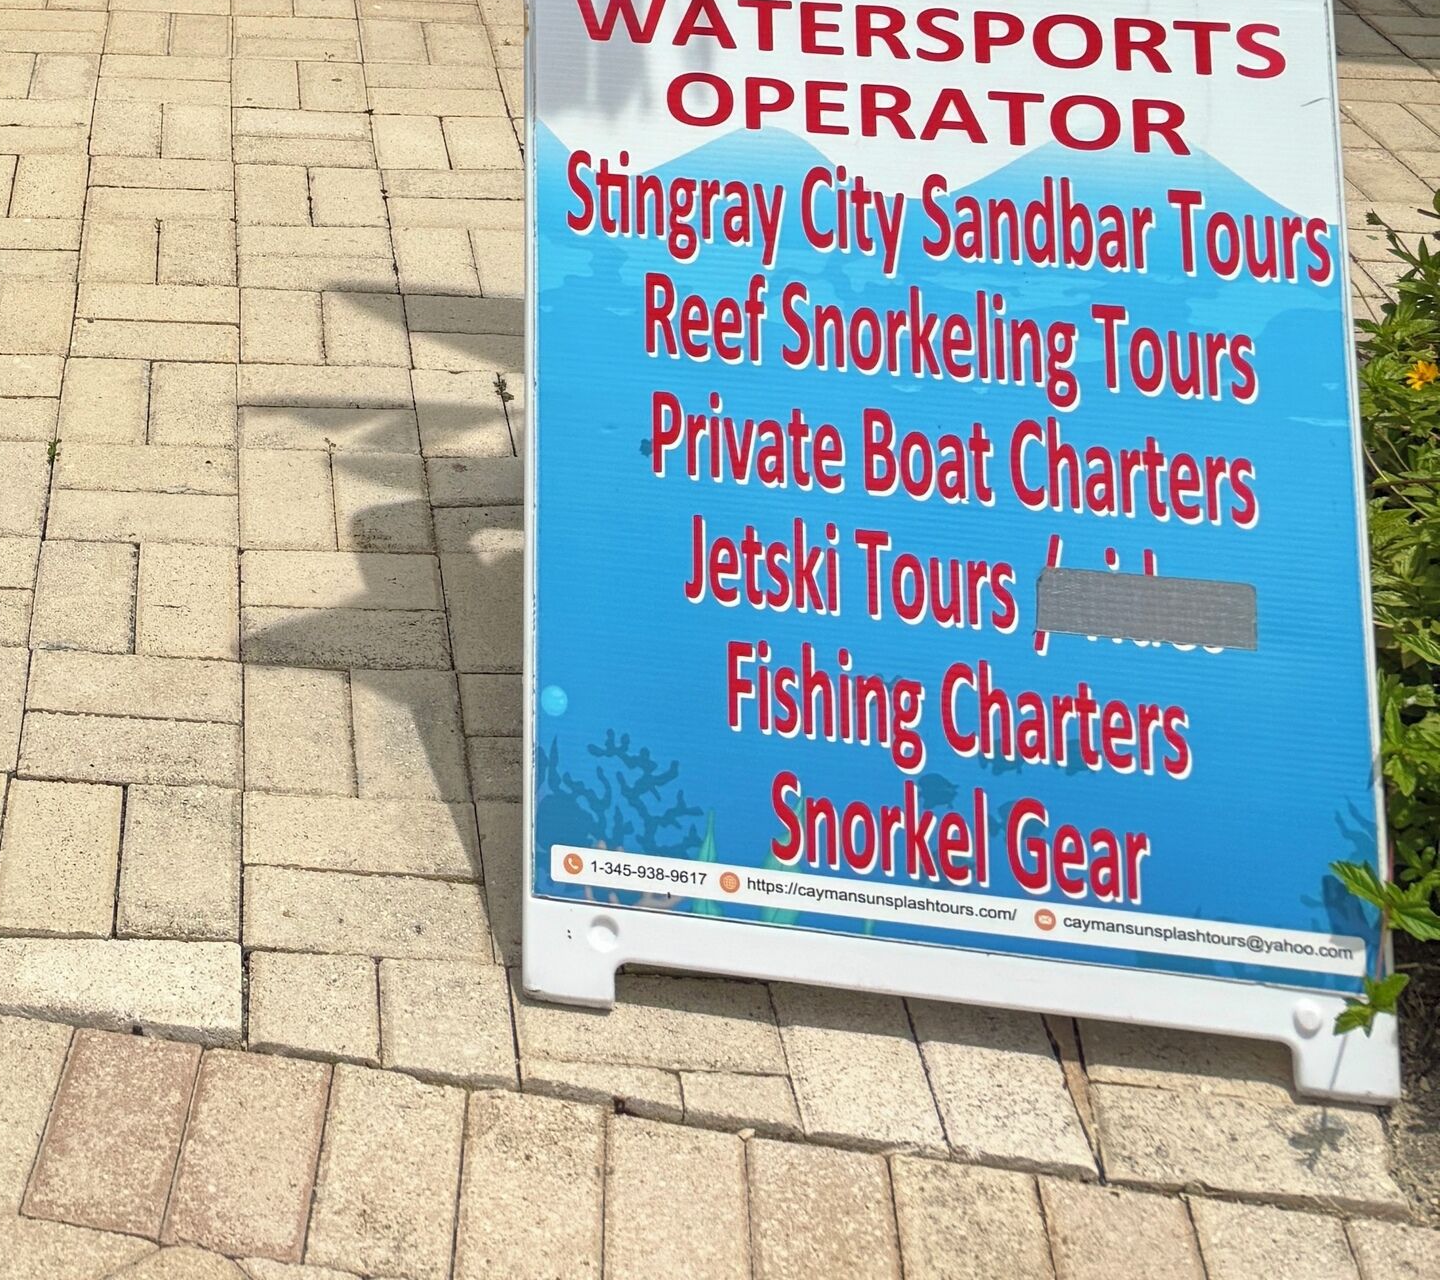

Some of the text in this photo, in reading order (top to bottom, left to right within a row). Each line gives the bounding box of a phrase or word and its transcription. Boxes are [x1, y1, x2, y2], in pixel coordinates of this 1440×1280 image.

[665, 71, 1194, 157] OPERATOR
[565, 149, 1337, 288] Stingray City Sandbar Tours
[643, 271, 1261, 413] Reef Snorkeling Tours
[650, 389, 1261, 530] Private Boat Charters
[683, 513, 842, 618] Jetski
[854, 528, 1018, 635] Tours
[726, 639, 1195, 780] Fishing Charters
[770, 769, 1152, 906] Snorkel Gear
[590, 858, 1354, 960] 1-345-938-9617 https://caymansunsplashtours.com/ caymansunsplashtours@yahoo.com
